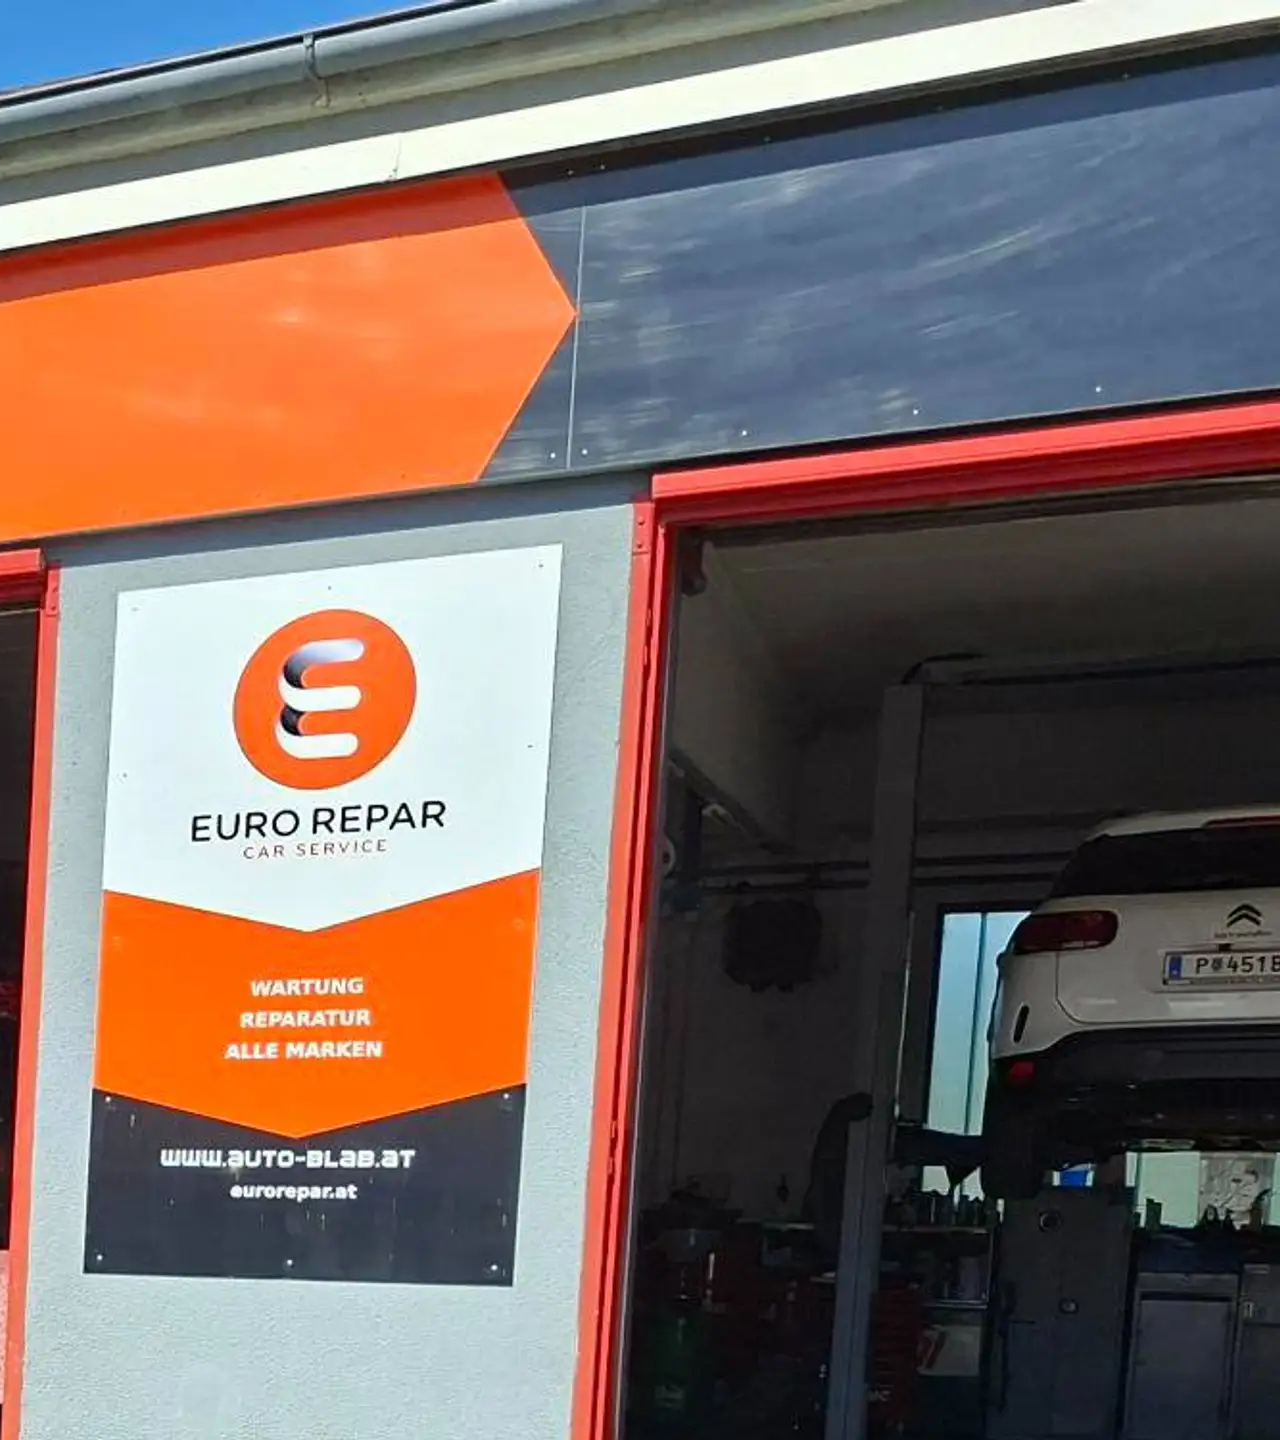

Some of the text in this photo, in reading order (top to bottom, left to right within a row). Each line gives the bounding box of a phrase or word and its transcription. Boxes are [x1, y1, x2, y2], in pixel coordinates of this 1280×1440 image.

[191, 800, 446, 842] EURO REPAR
[243, 839, 388, 860] CAR SERVICE
[250, 977, 364, 997] WARTUNG
[239, 1009, 371, 1029] REPARATUR
[224, 1040, 384, 1060] ALLE MARKEN
[230, 1182, 358, 1203] eurorepar.at
